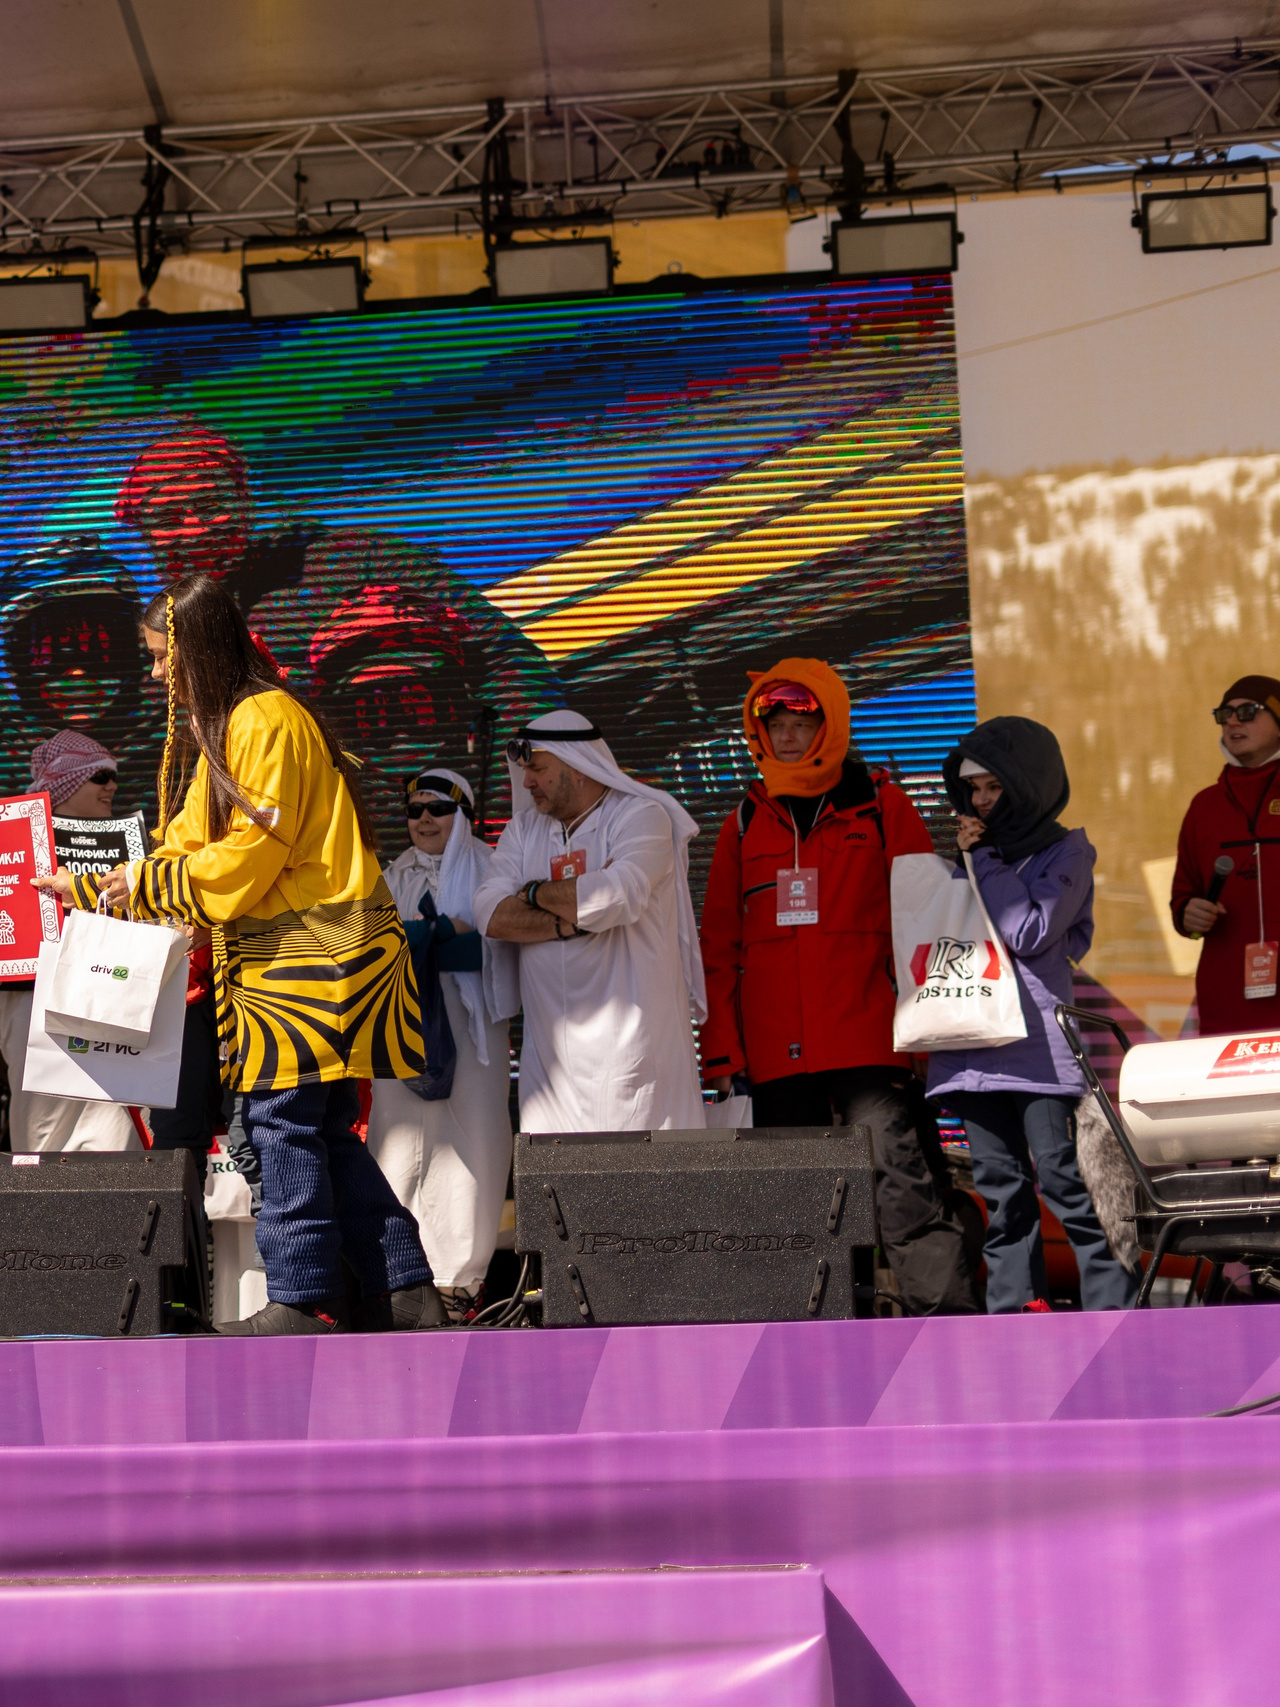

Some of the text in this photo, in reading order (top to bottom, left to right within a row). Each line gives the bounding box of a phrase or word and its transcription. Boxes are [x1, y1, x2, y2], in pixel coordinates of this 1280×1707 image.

[55, 846, 120, 858] СЕРТИФИКАТ
[90, 964, 128, 979] drivee
[577, 1231, 816, 1254] ProTone
